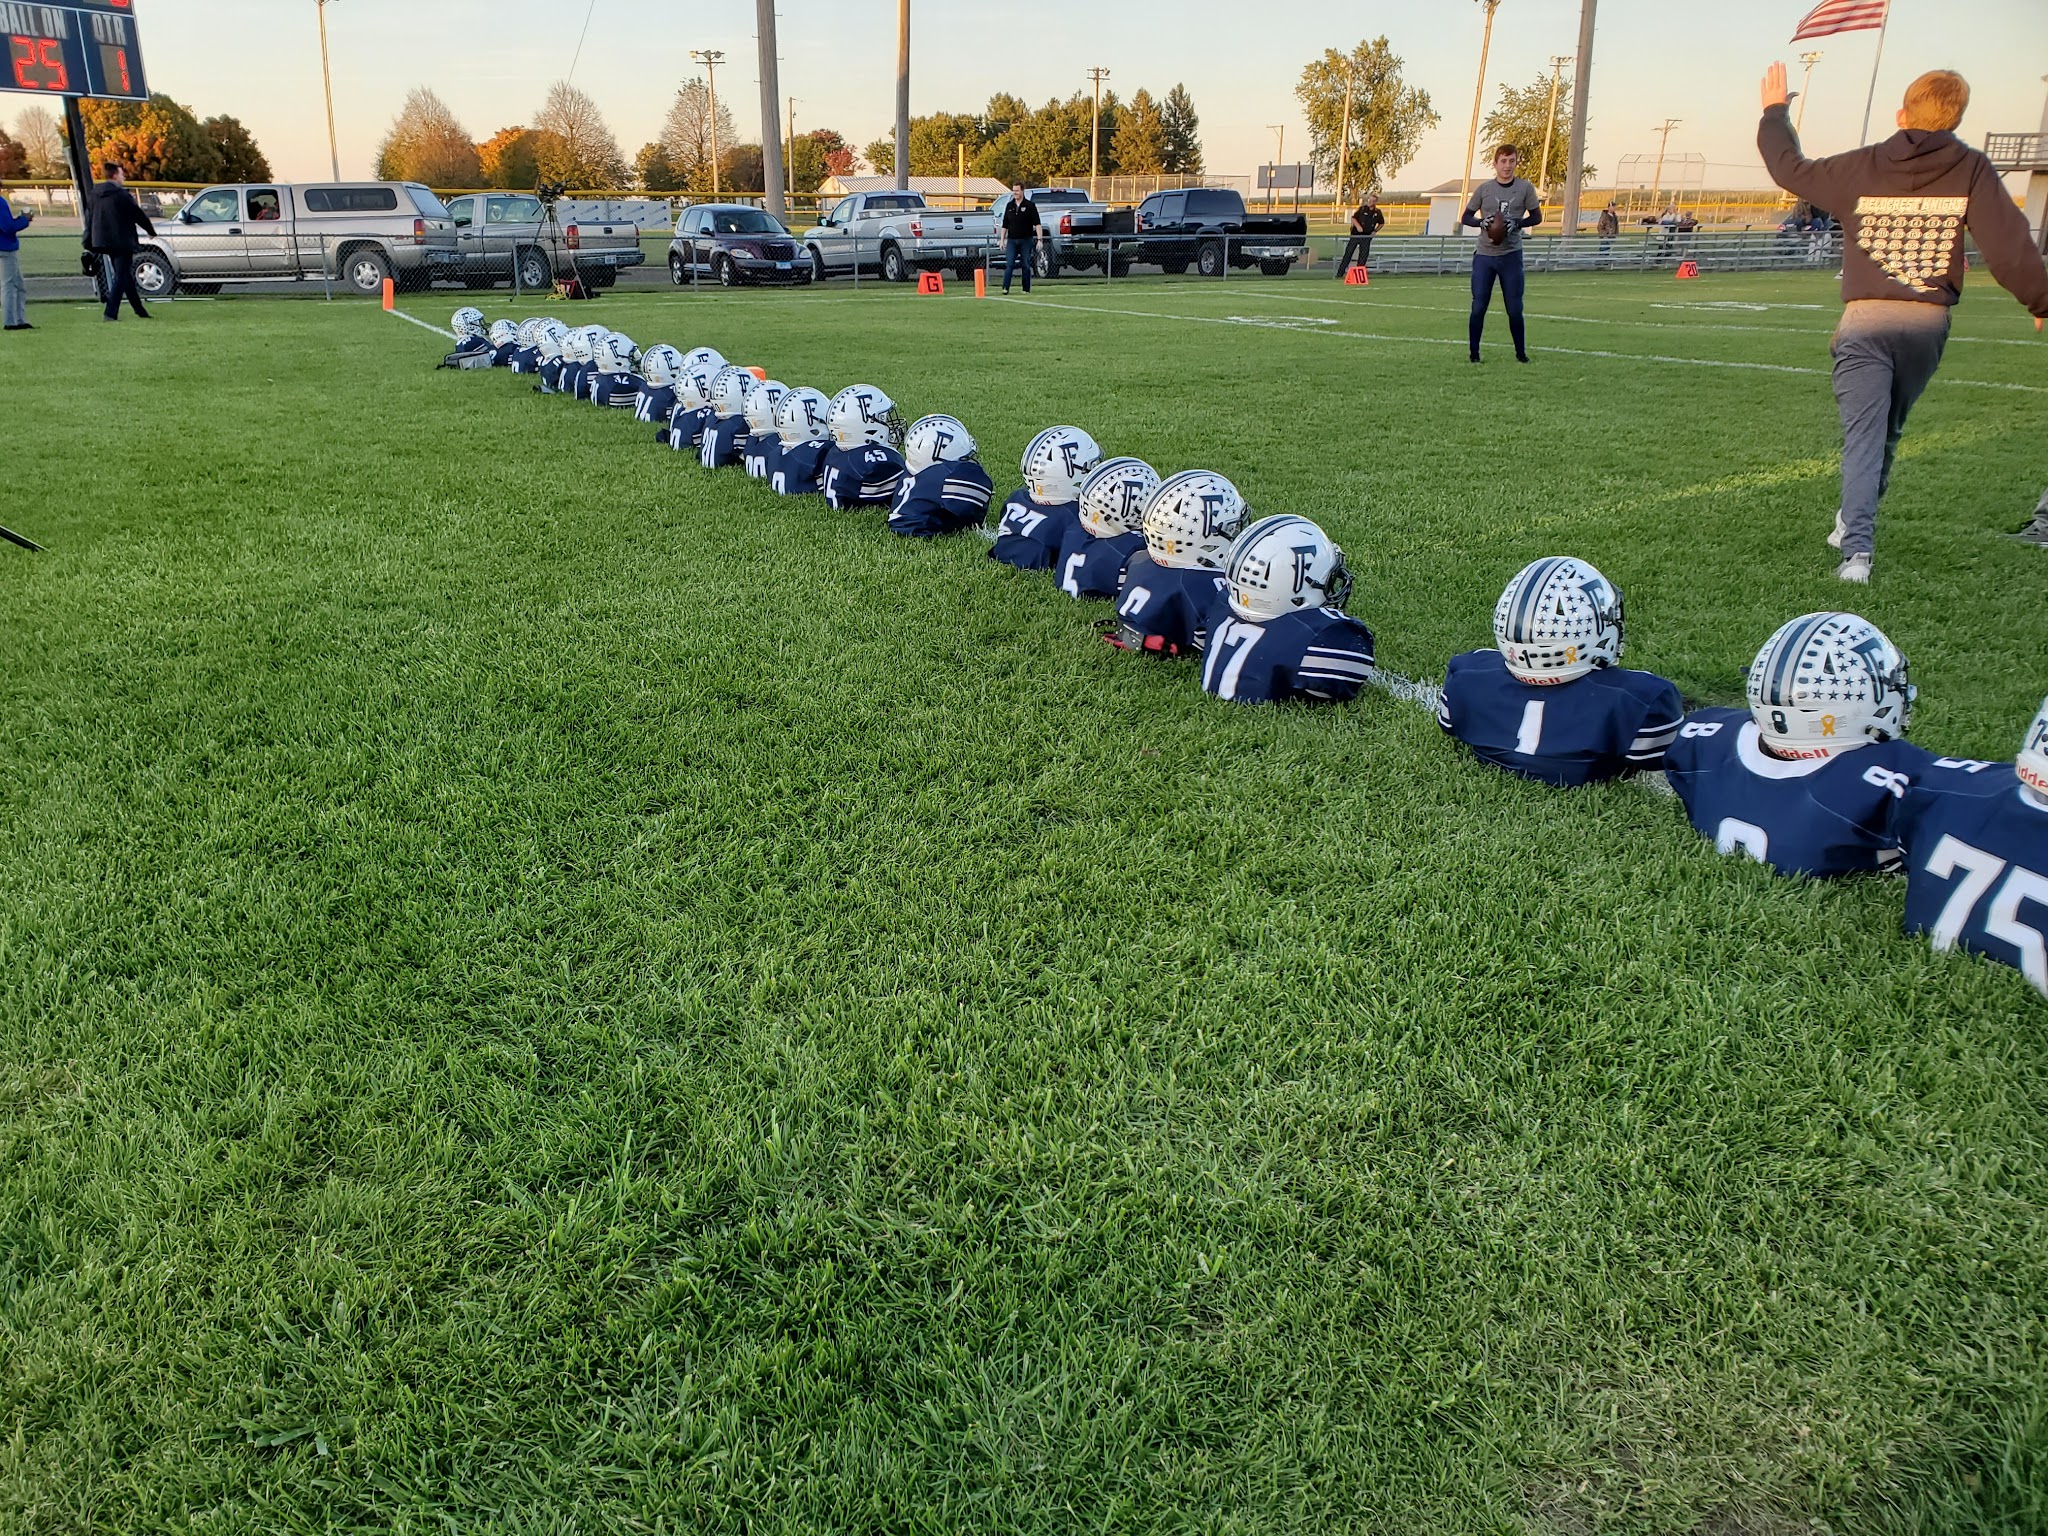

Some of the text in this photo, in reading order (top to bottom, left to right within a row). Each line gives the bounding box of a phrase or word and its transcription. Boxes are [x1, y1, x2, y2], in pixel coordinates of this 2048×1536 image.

[0, 2, 68, 39] BALL ON
[92, 14, 126, 45] QTR
[12, 36, 69, 90] 25
[117, 50, 130, 92] 1
[926, 275, 939, 292] G
[1353, 269, 1366, 283] 10
[1058, 441, 1079, 479] F
[1120, 480, 1144, 519] F
[1199, 494, 1224, 539] F
[1289, 545, 1317, 594] F
[1203, 615, 1266, 700] 17
[1514, 700, 1545, 756] 1
[1771, 710, 1789, 735] 8
[1774, 748, 1830, 760] iddell
[1925, 833, 2048, 1000] 75
